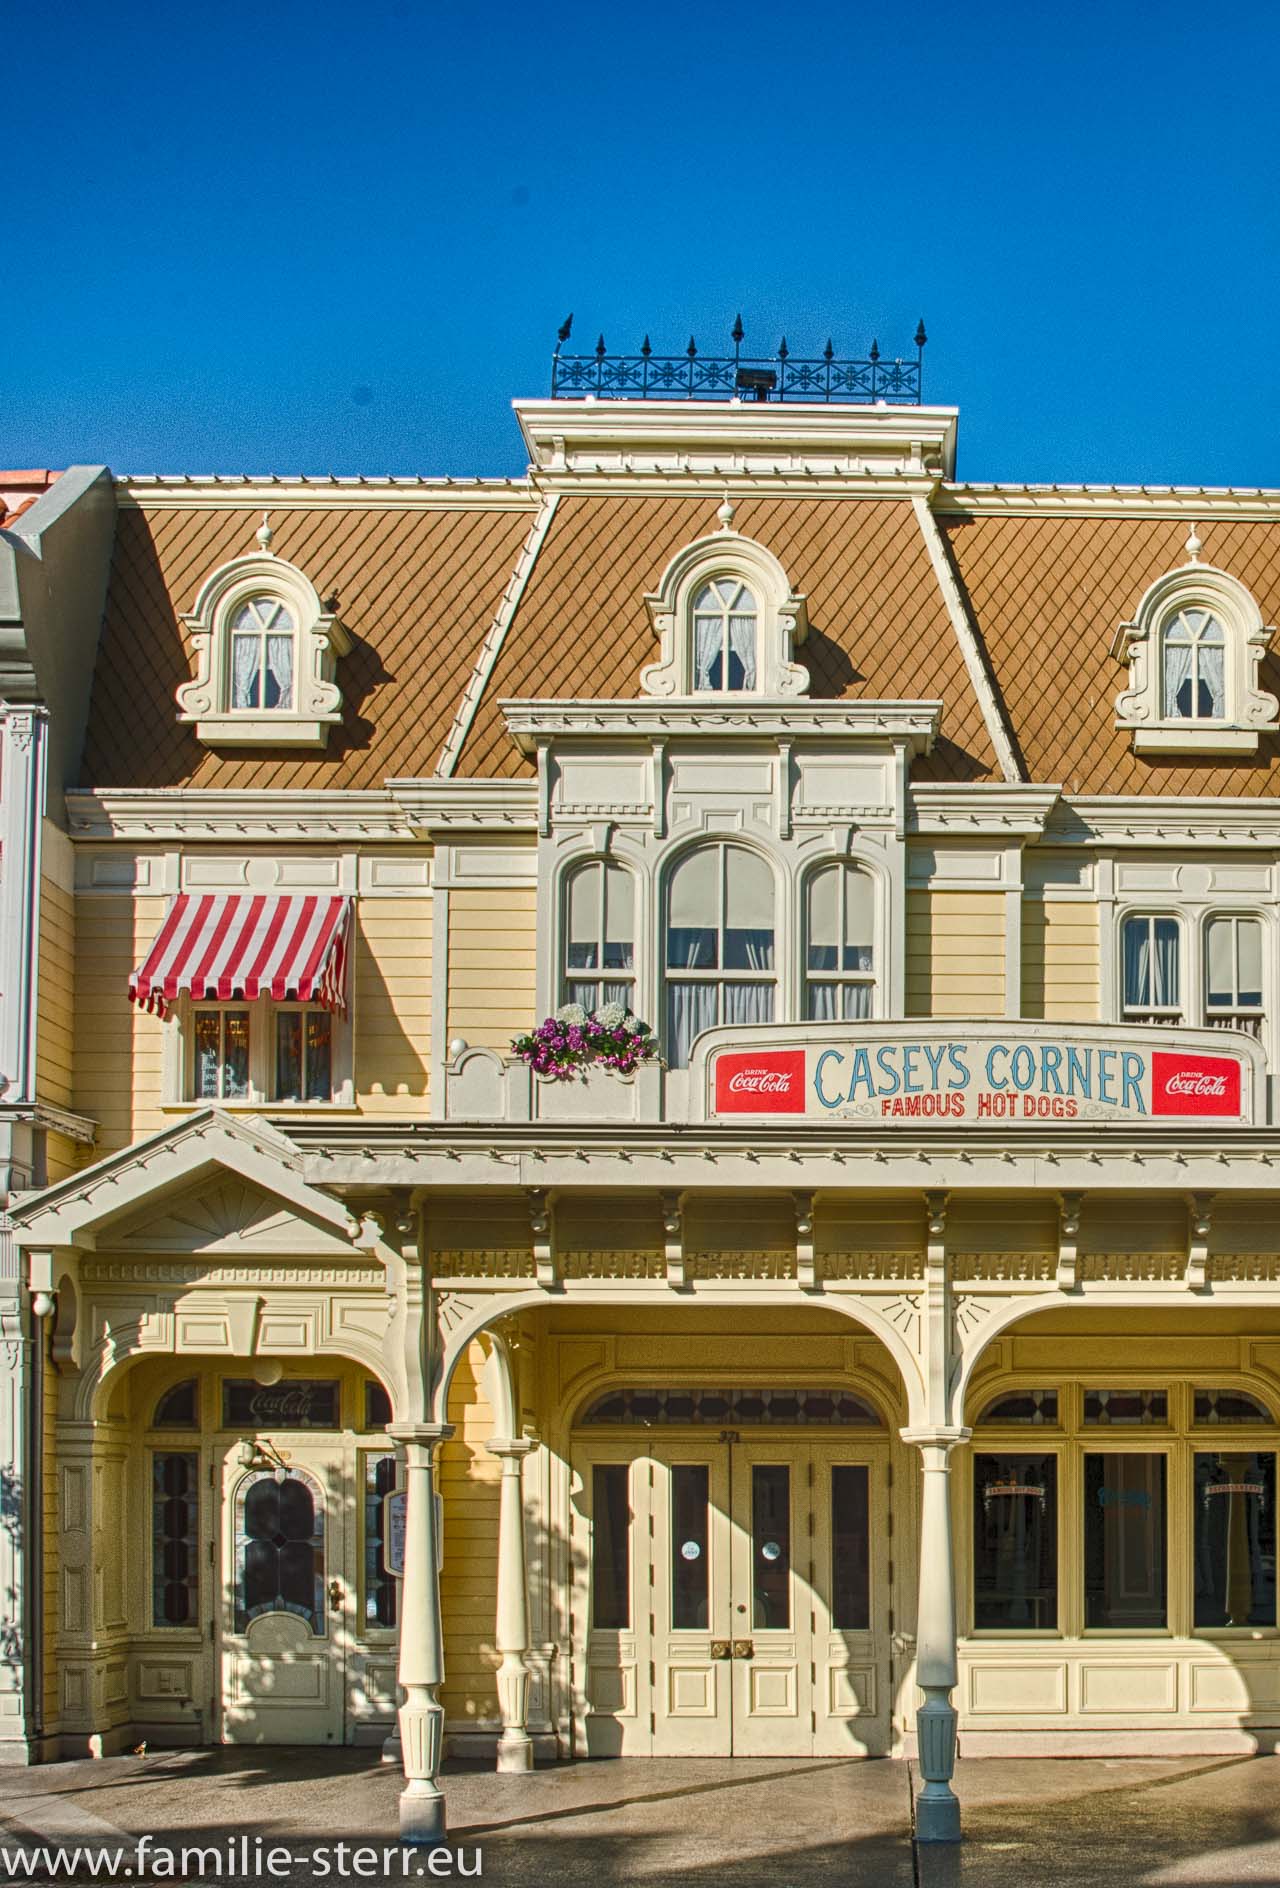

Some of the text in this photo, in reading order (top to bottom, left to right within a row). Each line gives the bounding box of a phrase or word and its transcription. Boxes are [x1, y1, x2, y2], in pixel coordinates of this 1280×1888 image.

[729, 1072, 793, 1093] Coca-Cola
[814, 1043, 1147, 1115] CASEY'S CORNER
[881, 1093, 1079, 1118] FAMOUS HOT DOGS
